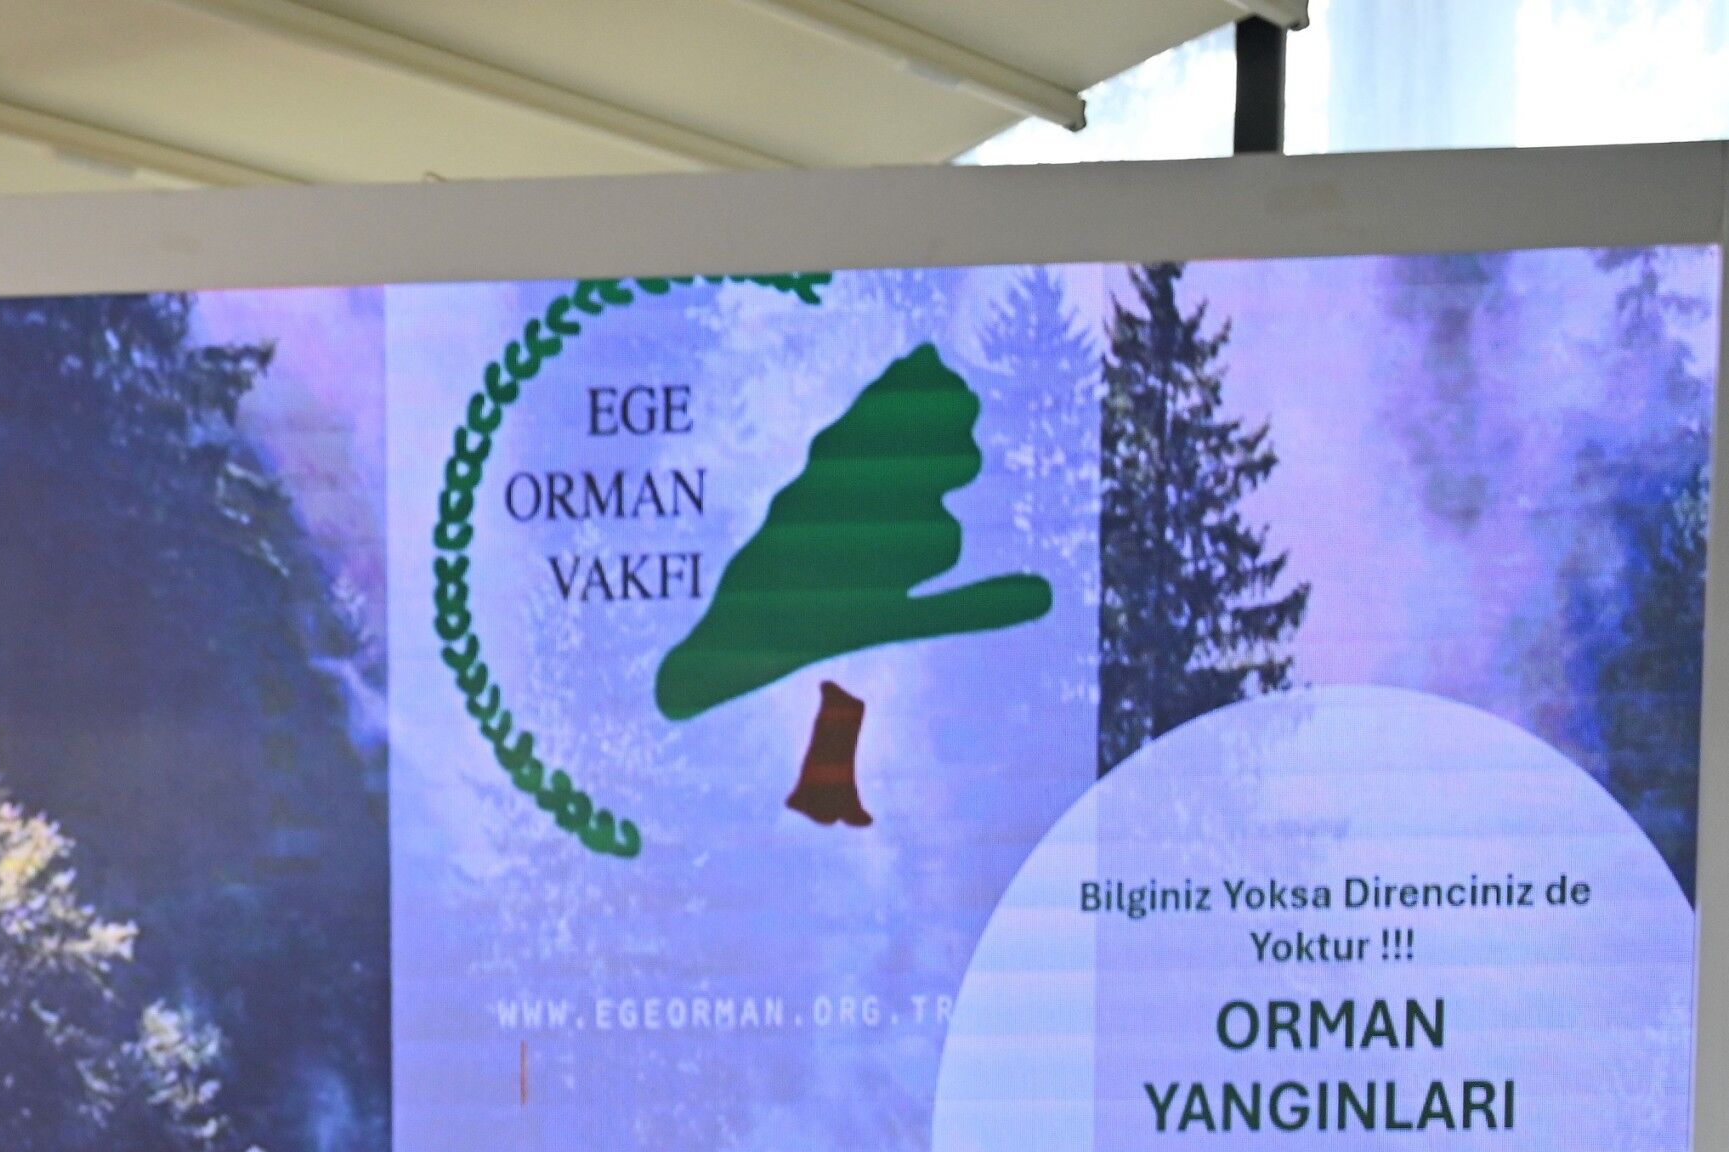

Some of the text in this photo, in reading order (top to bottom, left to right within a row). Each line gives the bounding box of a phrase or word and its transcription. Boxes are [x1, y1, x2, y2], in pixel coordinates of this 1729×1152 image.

[587, 384, 693, 437] EGE
[504, 468, 706, 522] ORMAN
[547, 552, 705, 602] VAKFI
[1080, 873, 1592, 920] Bilginiz Yoksa Direnciniz de
[1249, 930, 1371, 963] Yoktur
[496, 996, 955, 1031] WWW.EGEORMAN.ORG.TR
[1215, 997, 1445, 1052] ORMAN
[1143, 1079, 1516, 1133] YANGINLARI
